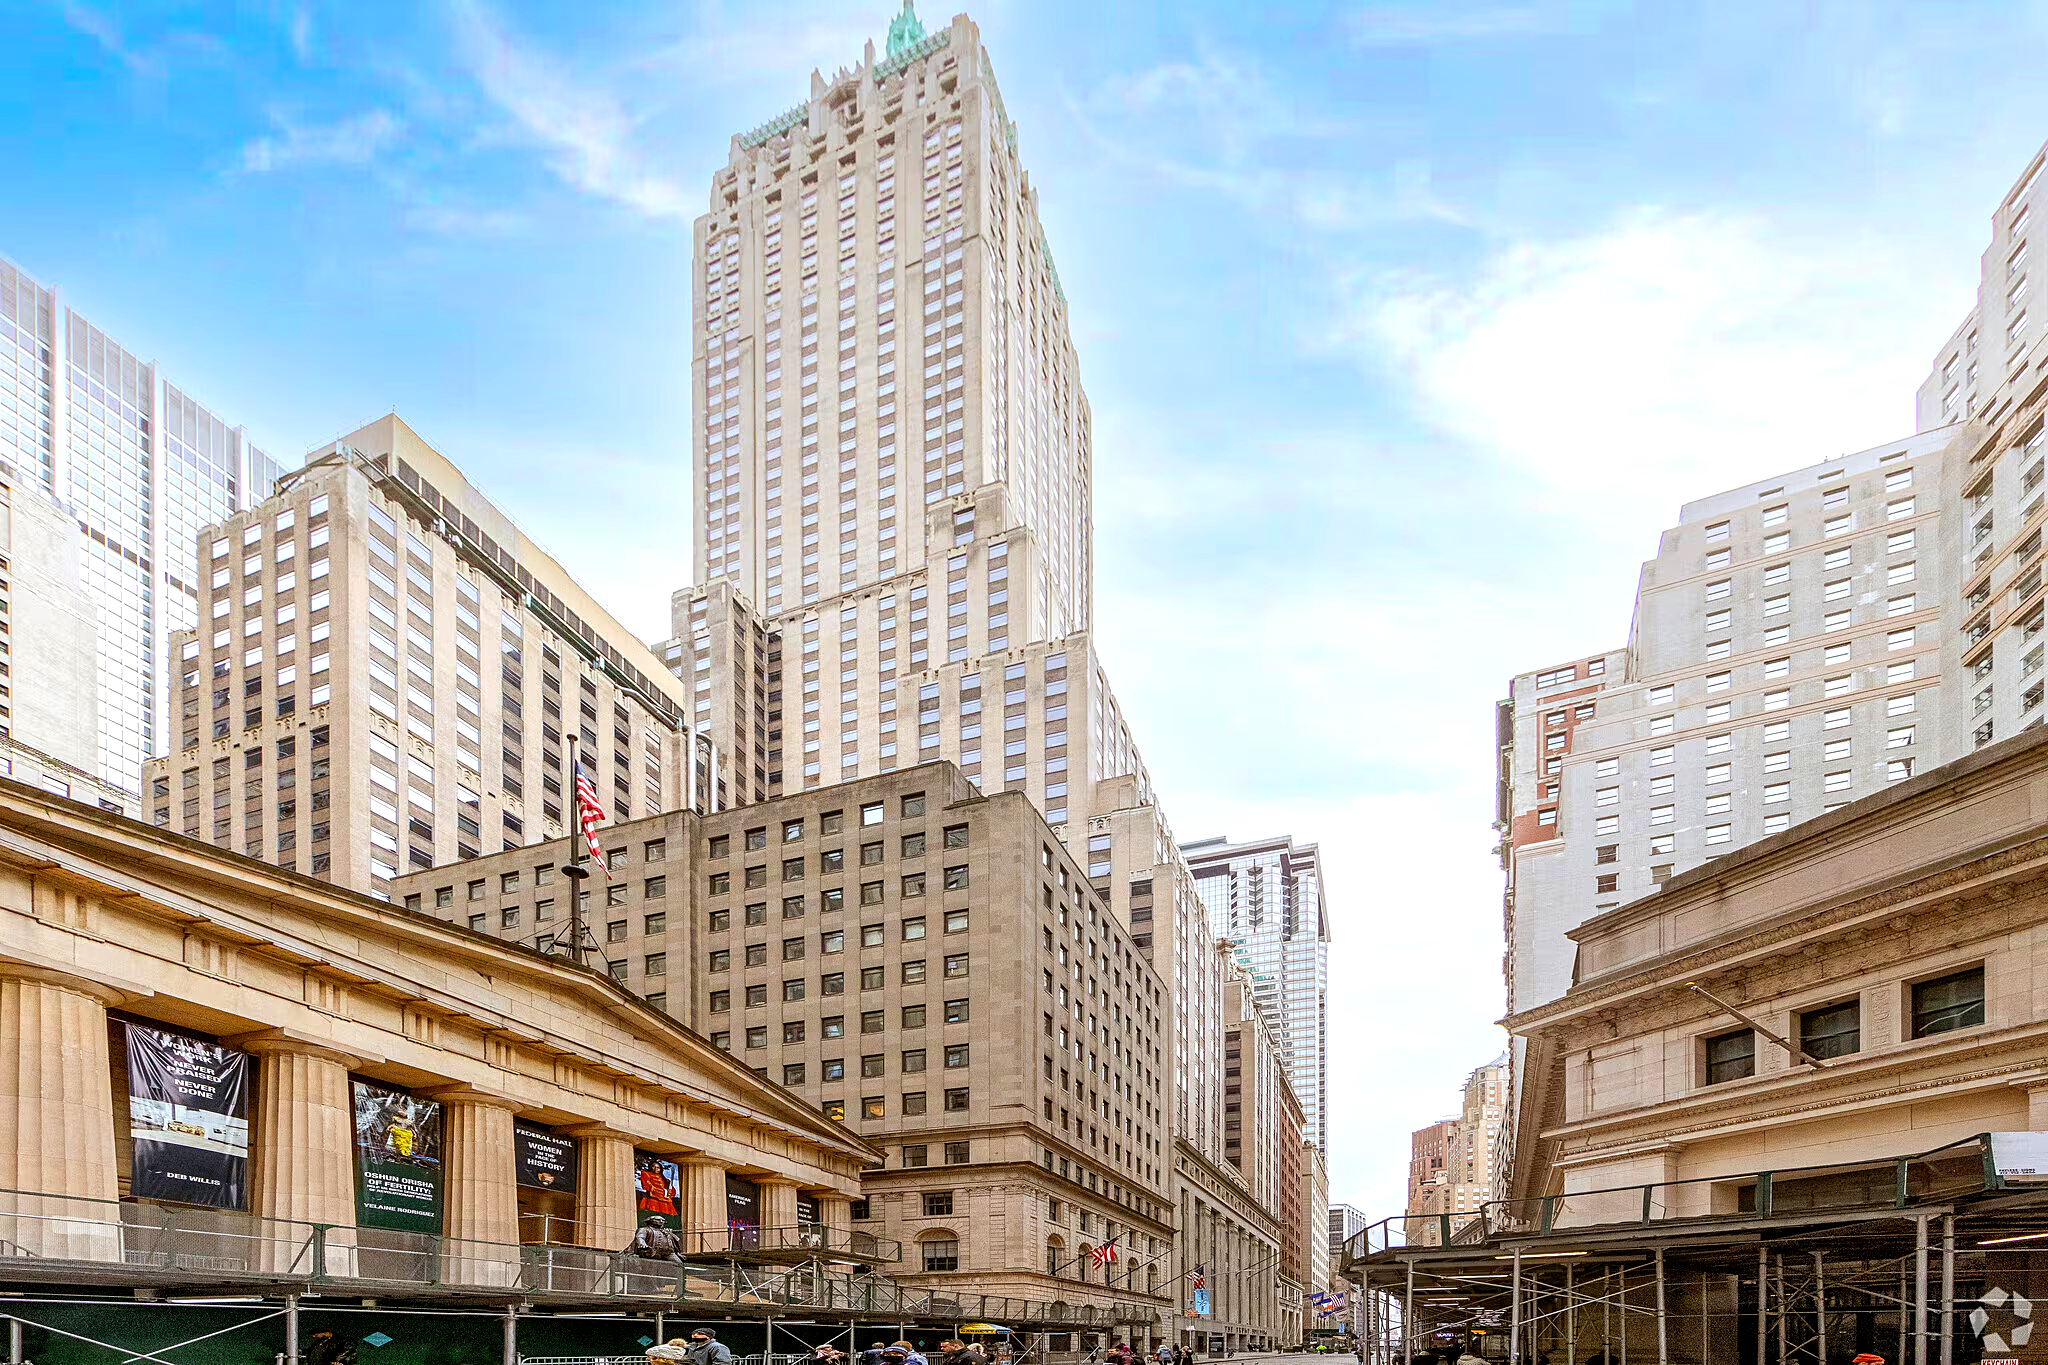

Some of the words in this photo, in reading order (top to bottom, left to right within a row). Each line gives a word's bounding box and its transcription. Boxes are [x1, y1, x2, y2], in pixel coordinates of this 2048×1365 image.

[173, 1049, 212, 1064] WORK
[167, 1065, 221, 1083] PRAISED
[174, 1060, 215, 1075] NEVER
[175, 1079, 216, 1093] NEVER
[179, 1086, 213, 1100] DONE
[516, 1128, 551, 1142] FEDERAL
[552, 1137, 573, 1148] HALL
[527, 1141, 562, 1156] WOMEN
[527, 1158, 565, 1172] HISTORY
[166, 1172, 188, 1180] DEB
[189, 1175, 221, 1186] WILLIS
[364, 1171, 400, 1183] OSHUN
[401, 1177, 434, 1189] ORISHA
[363, 1202, 397, 1212] YELAINE
[397, 1207, 435, 1218] RODRIGUEZ
